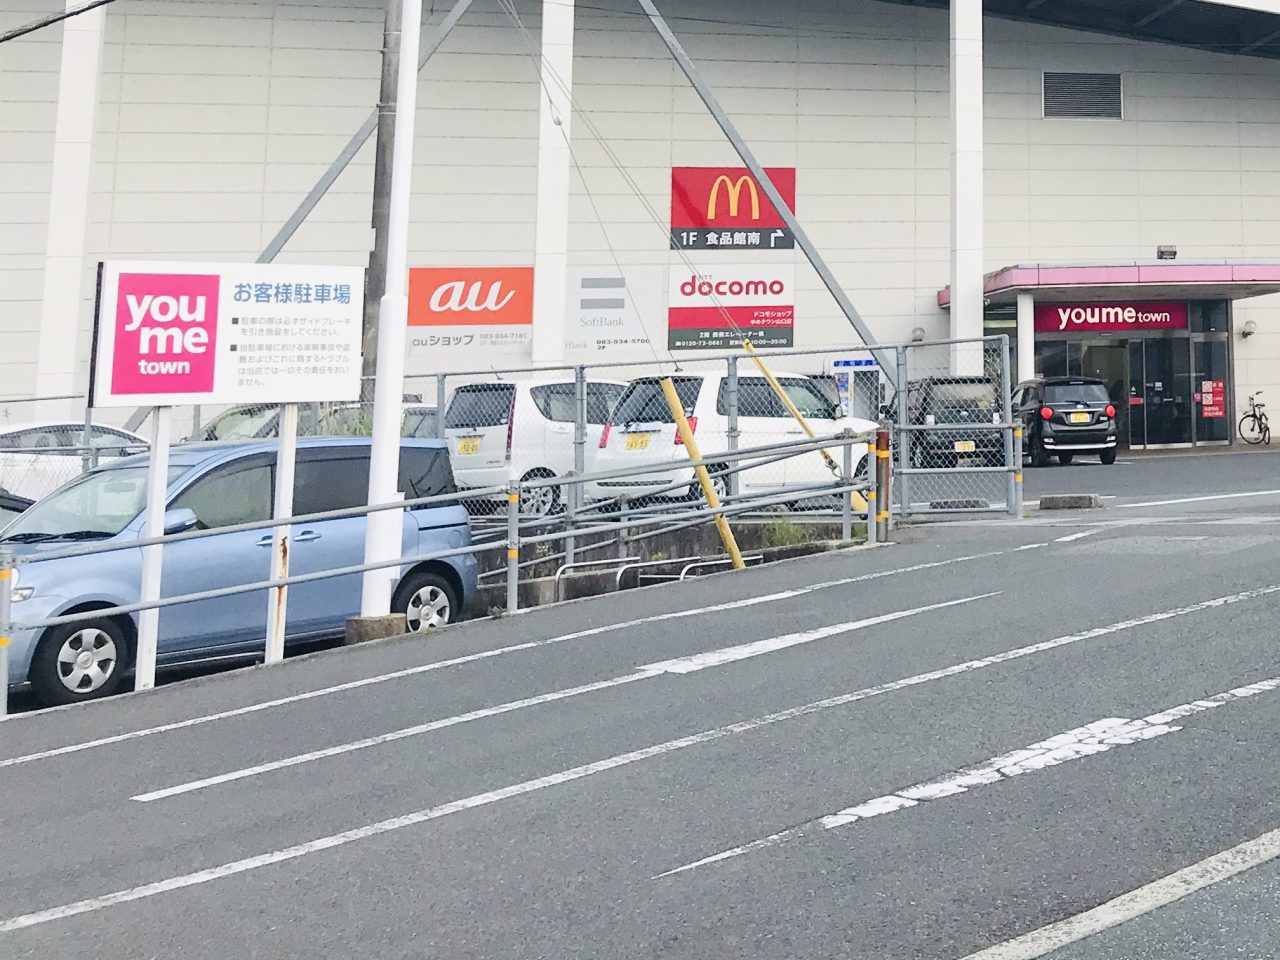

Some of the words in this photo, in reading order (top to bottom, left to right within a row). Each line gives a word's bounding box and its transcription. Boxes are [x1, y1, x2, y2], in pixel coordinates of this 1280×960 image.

[680, 231, 698, 246] 1F
[705, 231, 760, 245] 食品館南
[233, 282, 352, 305] お客様駐車場
[429, 280, 516, 312] au
[680, 274, 785, 297] docomo
[124, 294, 207, 332] you
[580, 316, 624, 327] SoftBank
[1057, 306, 1137, 331] youme
[1137, 311, 1171, 323] town
[138, 326, 209, 354] me
[411, 334, 475, 347] auショップ
[137, 358, 191, 375] town
